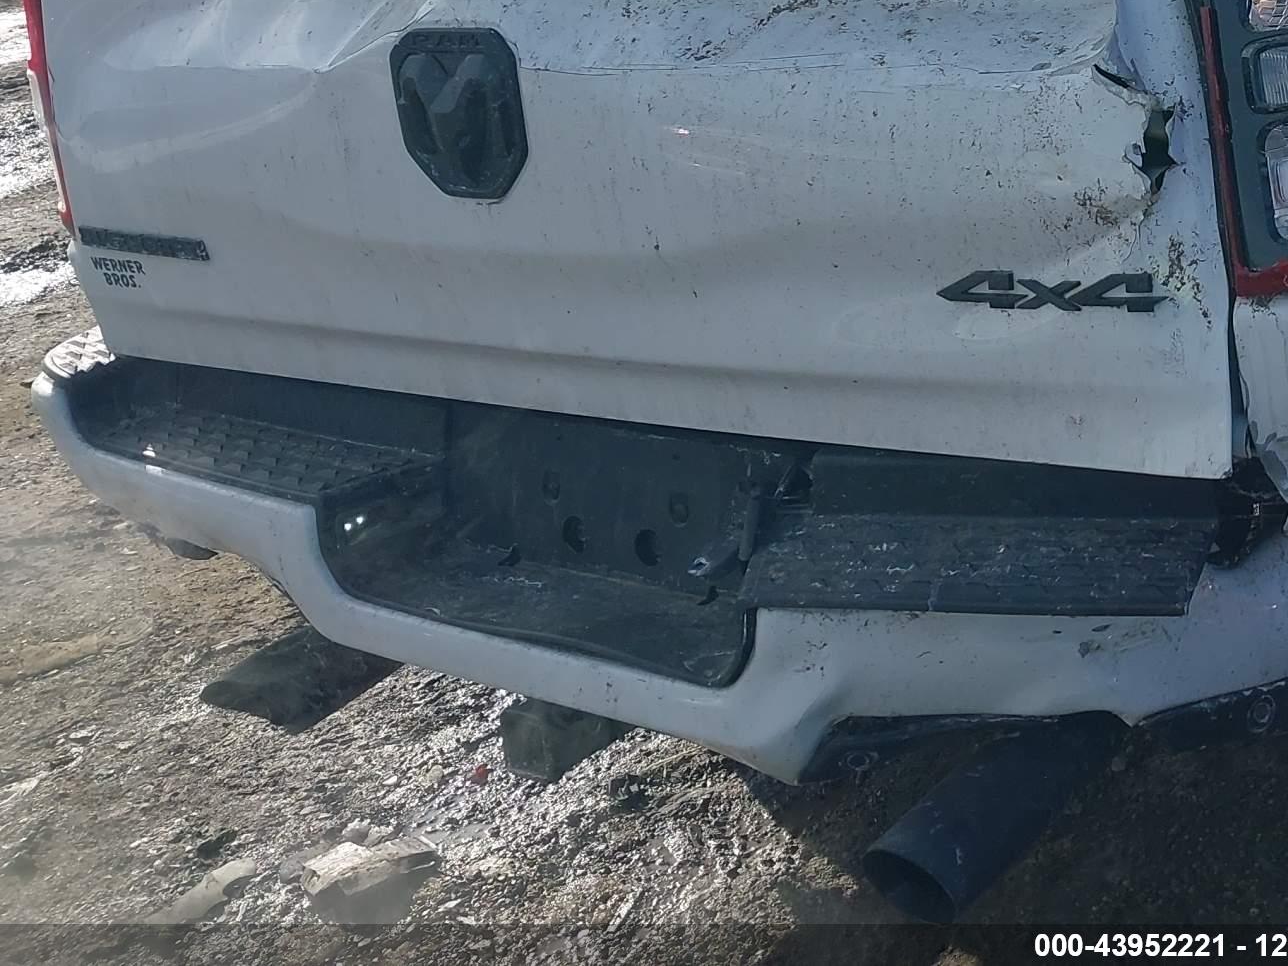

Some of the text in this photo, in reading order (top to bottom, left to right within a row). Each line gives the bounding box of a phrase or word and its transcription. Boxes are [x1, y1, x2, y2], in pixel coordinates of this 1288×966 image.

[409, 33, 484, 49] RAM
[89, 255, 146, 275] WERNER
[103, 272, 142, 288] BROS.
